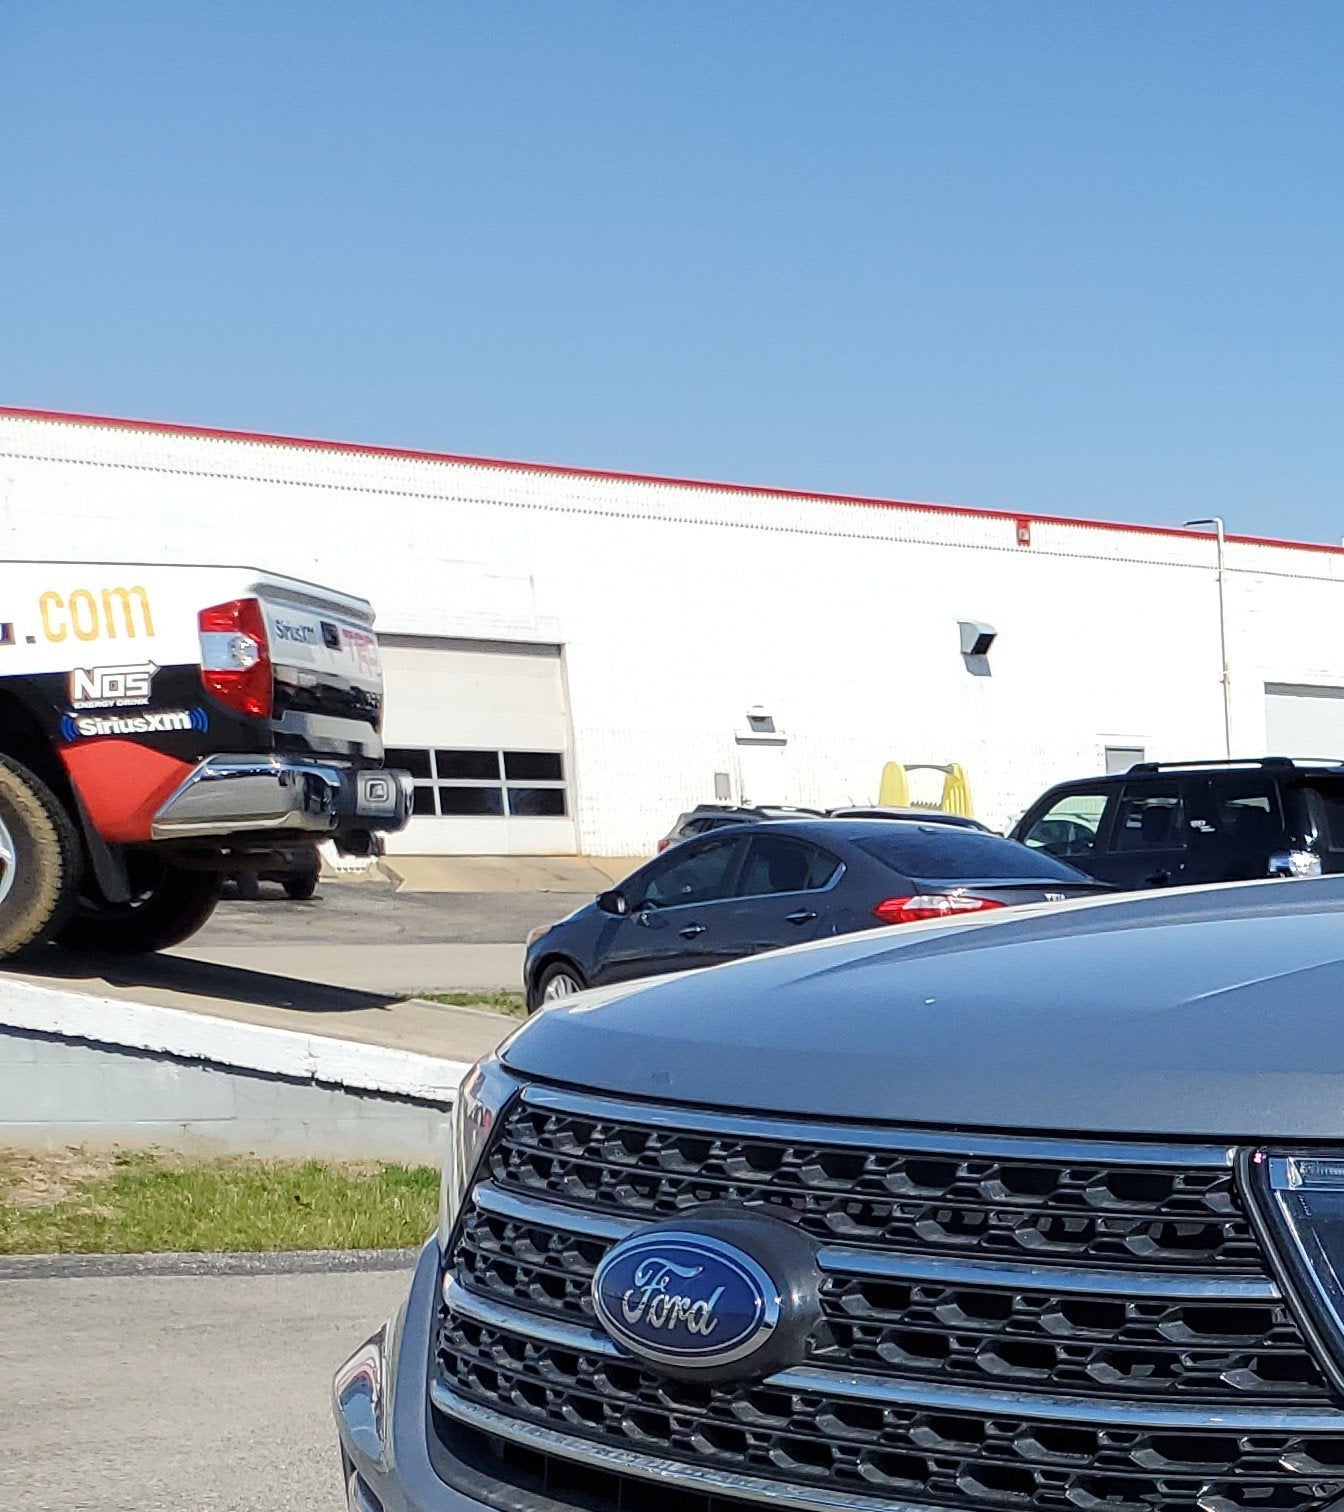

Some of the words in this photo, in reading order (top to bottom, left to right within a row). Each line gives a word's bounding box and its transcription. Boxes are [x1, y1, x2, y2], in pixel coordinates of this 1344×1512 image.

[73, 662, 160, 700] NOS
[74, 700, 115, 709] ENERGY
[622, 1256, 726, 1337] Ford
